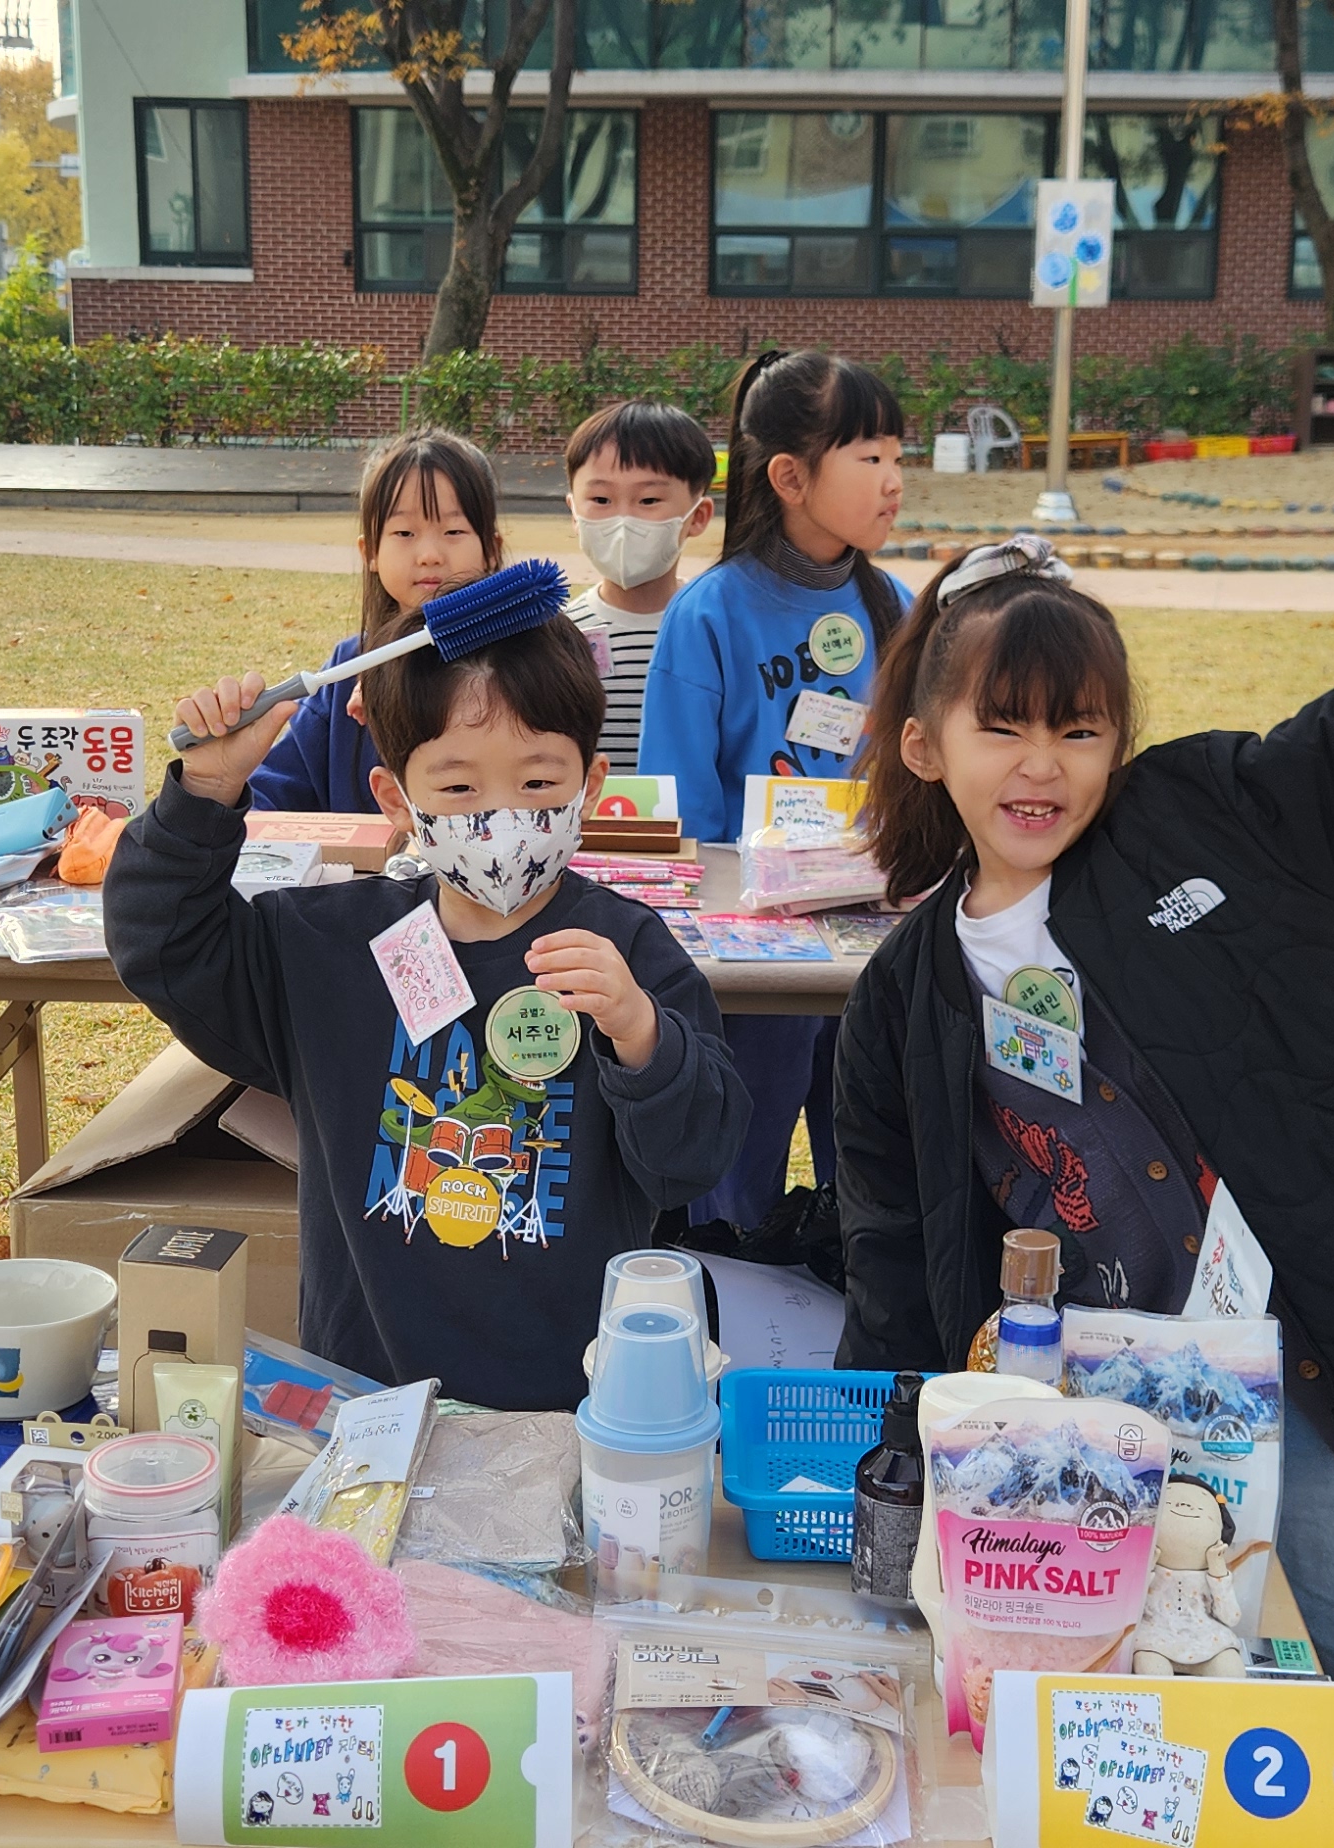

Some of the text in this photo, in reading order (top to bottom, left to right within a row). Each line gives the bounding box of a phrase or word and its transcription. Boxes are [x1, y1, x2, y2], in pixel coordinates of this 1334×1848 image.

[821, 637, 853, 653] 신예서
[17, 726, 36, 751] 두
[41, 726, 79, 751] 조각
[82, 726, 134, 774] 동물
[1155, 885, 1187, 910] THE
[1147, 896, 1195, 928] NORTH
[1166, 906, 1203, 934] FACE
[519, 1008, 546, 1019] 금별2
[1026, 991, 1061, 1016] 태인
[507, 1024, 561, 1043] 서주안
[1008, 1036, 1054, 1067] 이태인
[441, 1180, 488, 1200] ROCK
[428, 1197, 498, 1224] SPIRIT
[157, 1230, 215, 1259] BOTTLE
[961, 1527, 1067, 1564] Himalaya
[964, 1559, 1121, 1597] PINK SALT
[129, 1595, 178, 1608] LOCK
[964, 1594, 1045, 1614] 히말라야 핑크솔트
[633, 1652, 720, 1665] DIY 키트
[275, 1717, 309, 1732] 모두가
[250, 1735, 333, 1768] 아나바다
[434, 1739, 457, 1791] 1
[1098, 1759, 1166, 1784] 아나바다
[1252, 1745, 1286, 1797] 2
